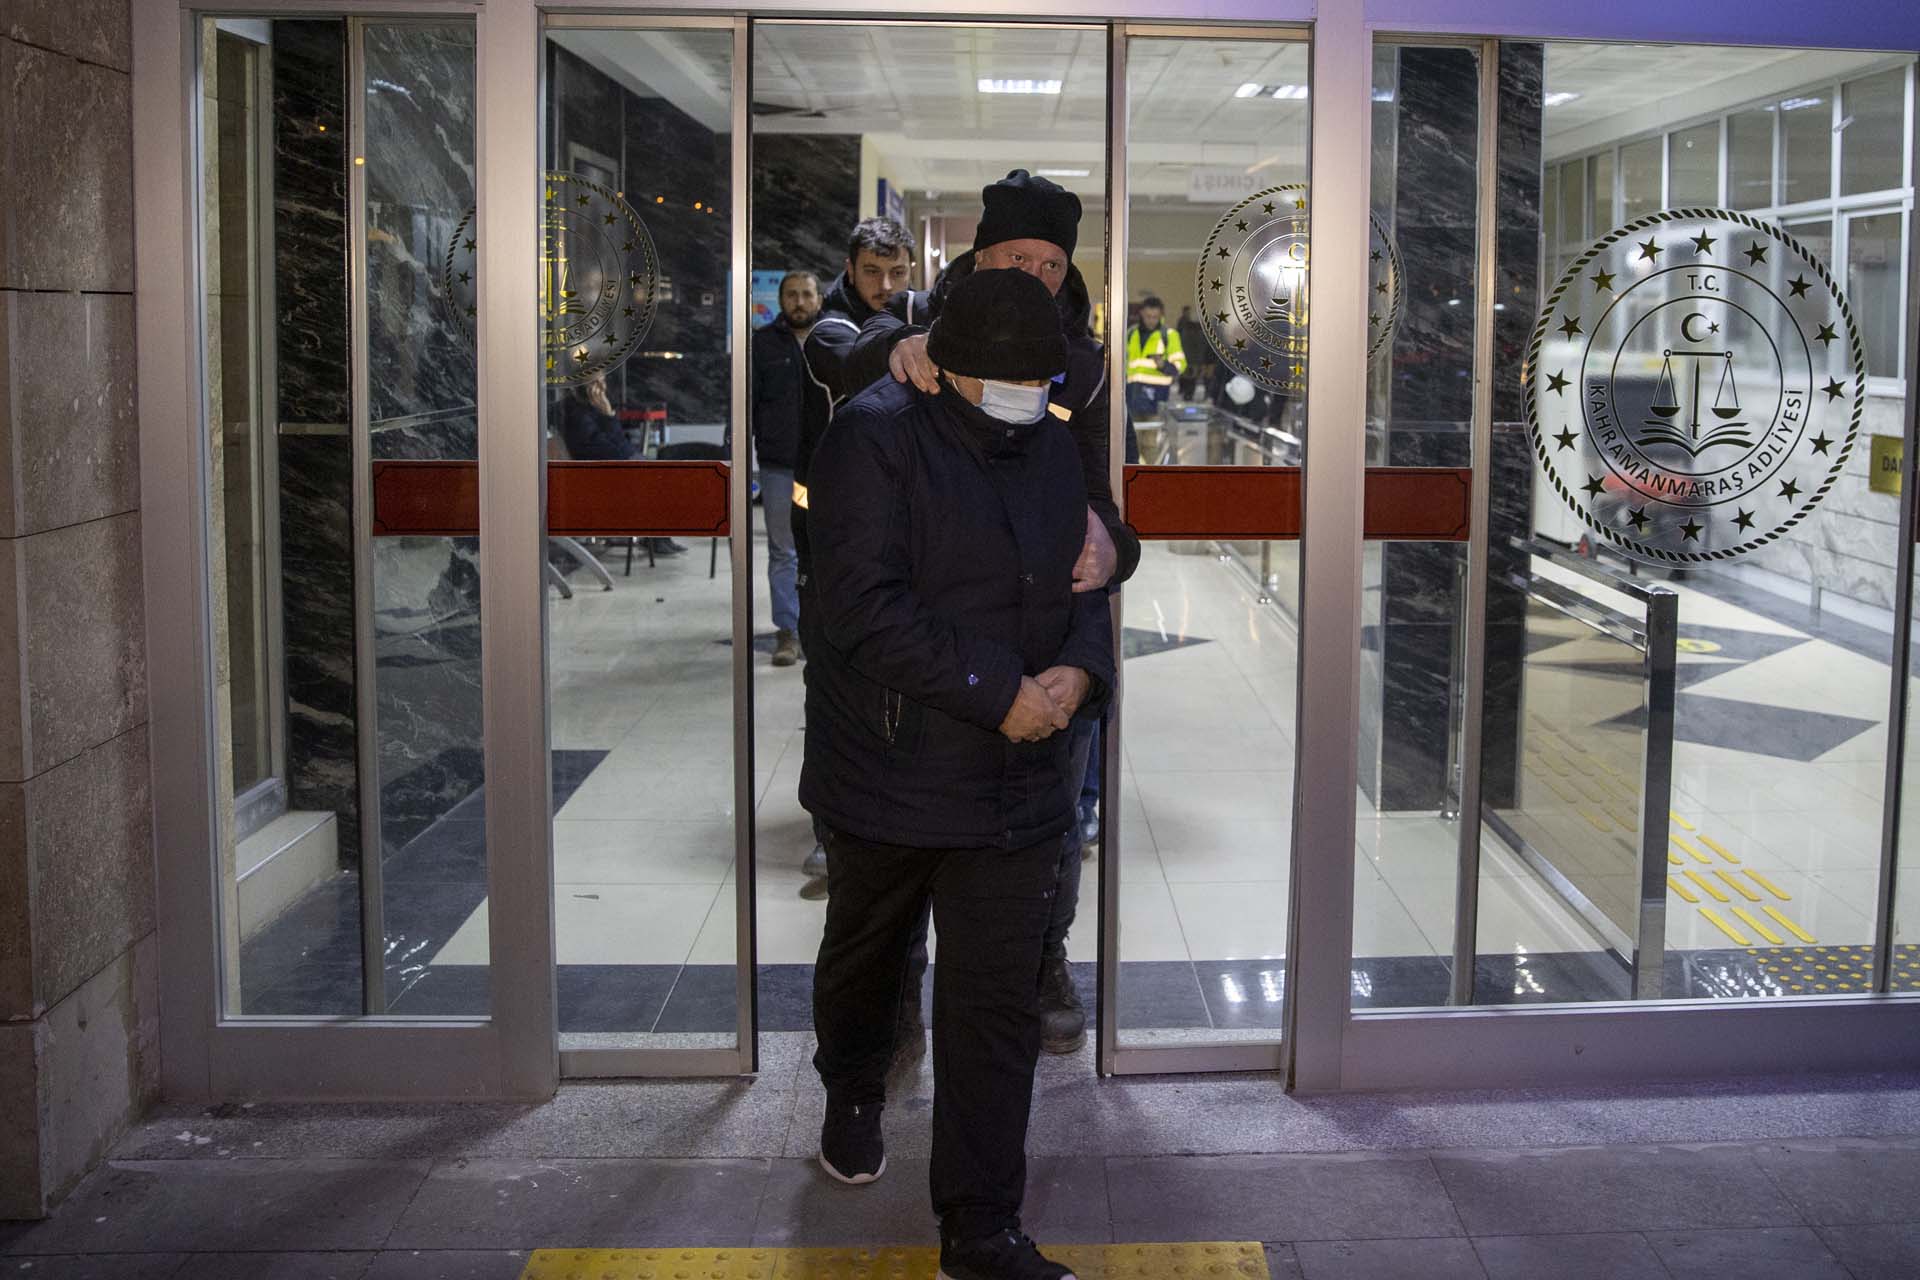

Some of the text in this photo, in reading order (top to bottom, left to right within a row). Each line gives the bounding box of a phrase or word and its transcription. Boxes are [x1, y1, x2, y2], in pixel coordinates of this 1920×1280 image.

[1687, 274, 1720, 292] T.C.
[1590, 385, 1803, 497] KAHRAMANMARAŞ ADLİYESİ
